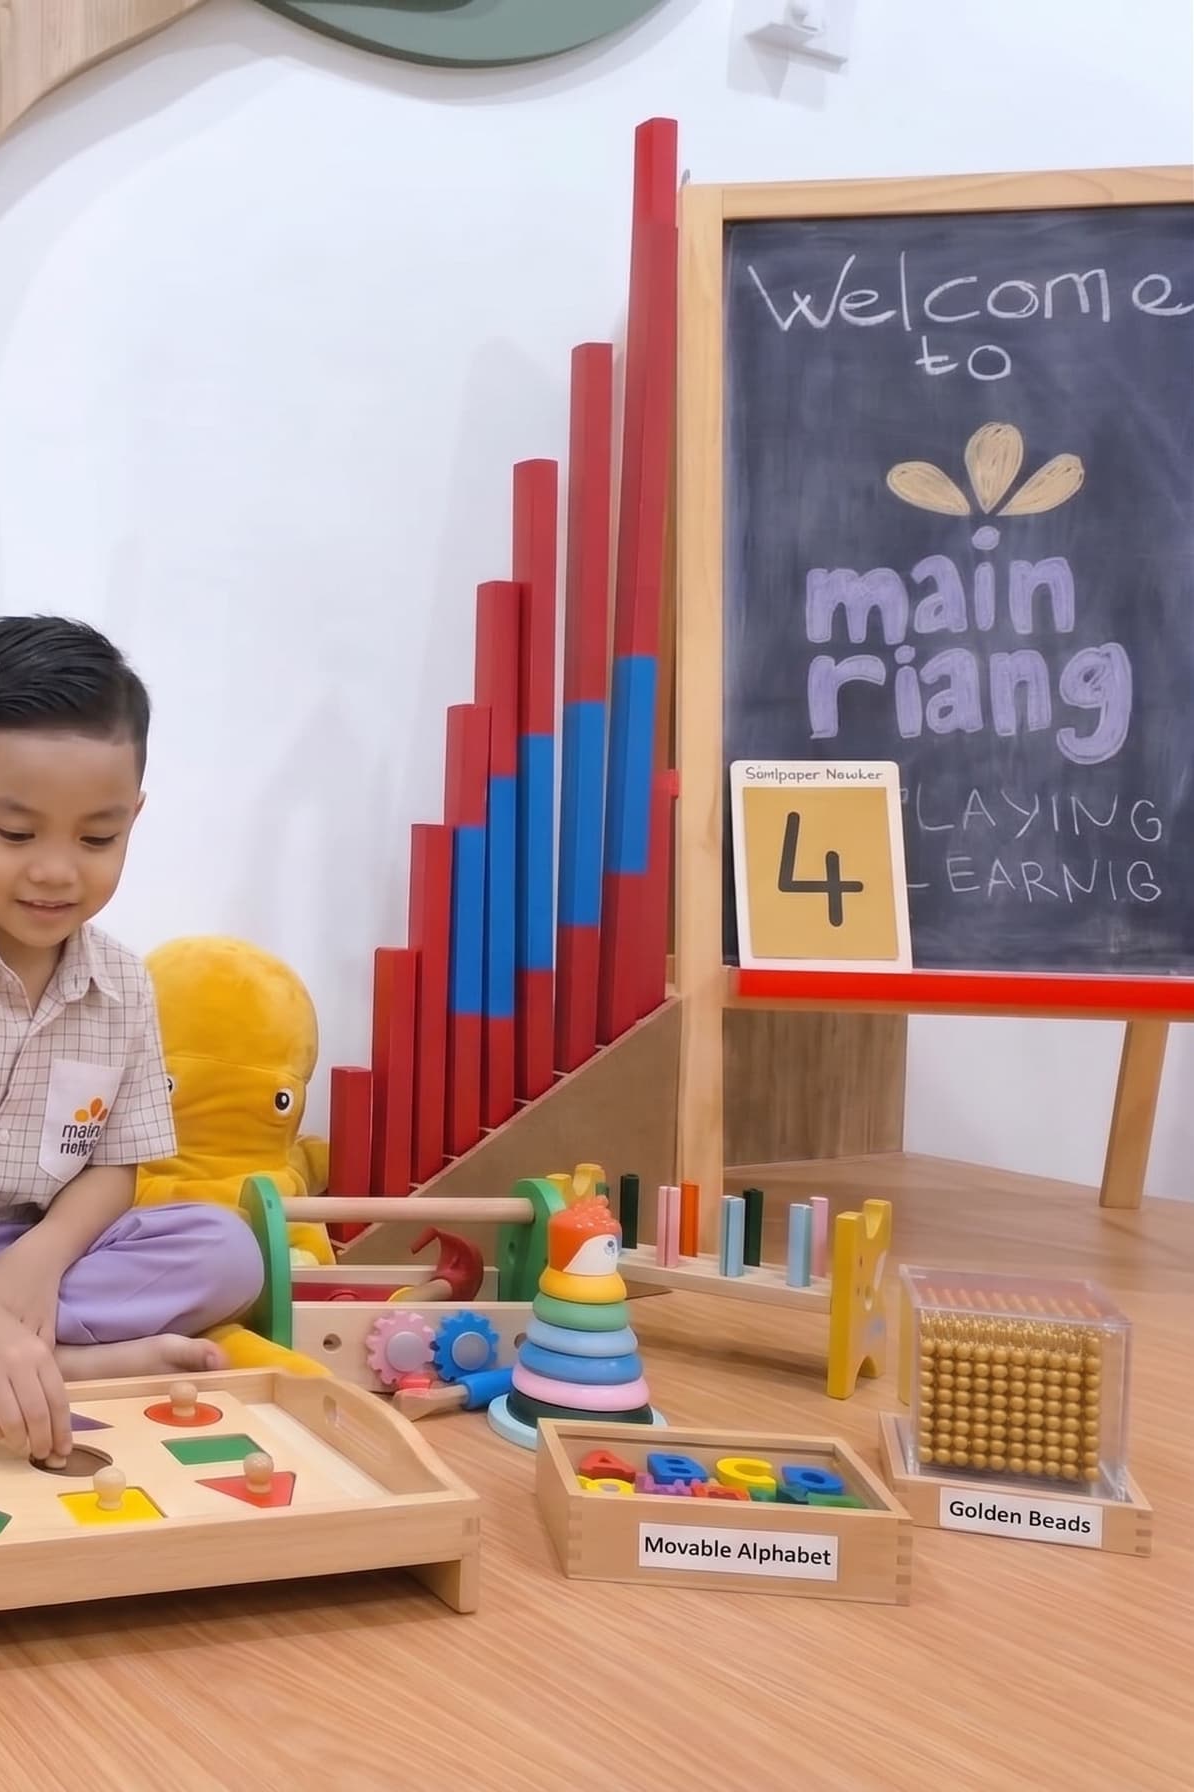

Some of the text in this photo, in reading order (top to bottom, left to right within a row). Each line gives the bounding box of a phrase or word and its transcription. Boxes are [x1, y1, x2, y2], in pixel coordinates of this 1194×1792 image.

[748, 251, 1194, 332] Welcome
[915, 335, 1012, 381] to
[806, 525, 1076, 646] main
[807, 641, 1133, 765] riang
[777, 811, 864, 928] 4
[644, 1535, 832, 1566] Movable Alphabet
[948, 1500, 1092, 1534] Golden Beads
